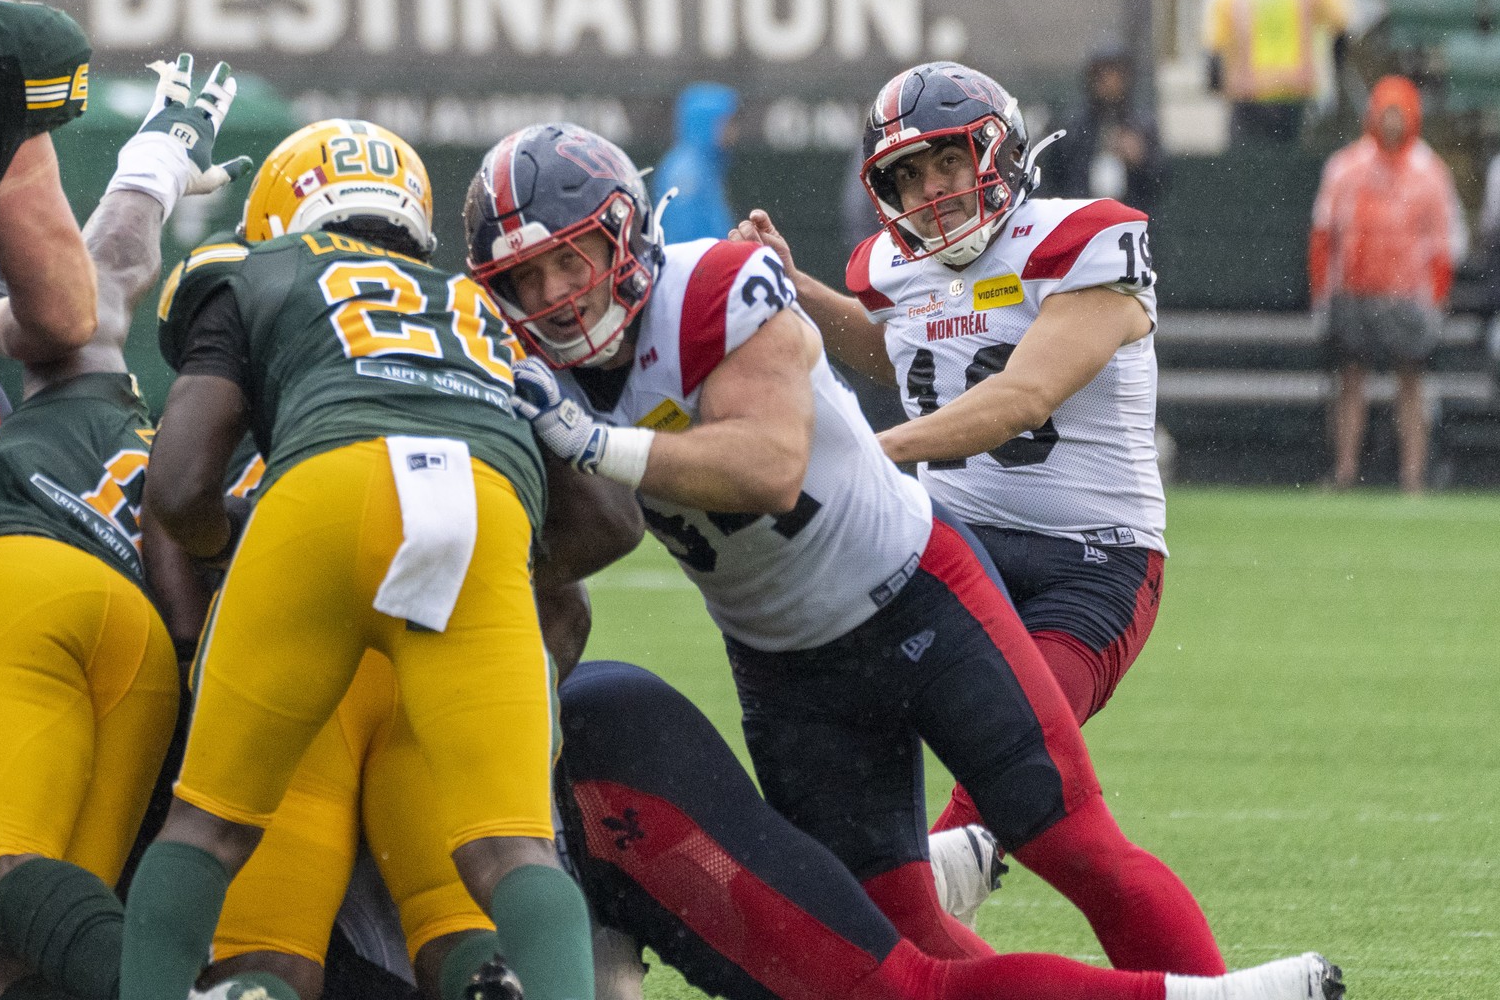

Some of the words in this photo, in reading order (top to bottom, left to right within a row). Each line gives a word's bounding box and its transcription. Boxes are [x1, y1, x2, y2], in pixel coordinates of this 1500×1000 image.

[173, 127, 193, 145] CFL
[329, 136, 399, 178] 20
[339, 184, 401, 199] EDMONTON
[1116, 231, 1153, 287] 19
[951, 282, 963, 293] LCF
[977, 284, 1019, 301] VIDÉOTRON
[908, 301, 944, 318] Freedom
[926, 310, 943, 318] mobile
[926, 311, 989, 342] MONTRÉAL
[383, 365, 427, 381] ARPI'S
[433, 374, 479, 398] NORTH
[52, 491, 89, 523] ARPI'S
[93, 521, 131, 560] NORTH
[1120, 530, 1132, 539] 44
